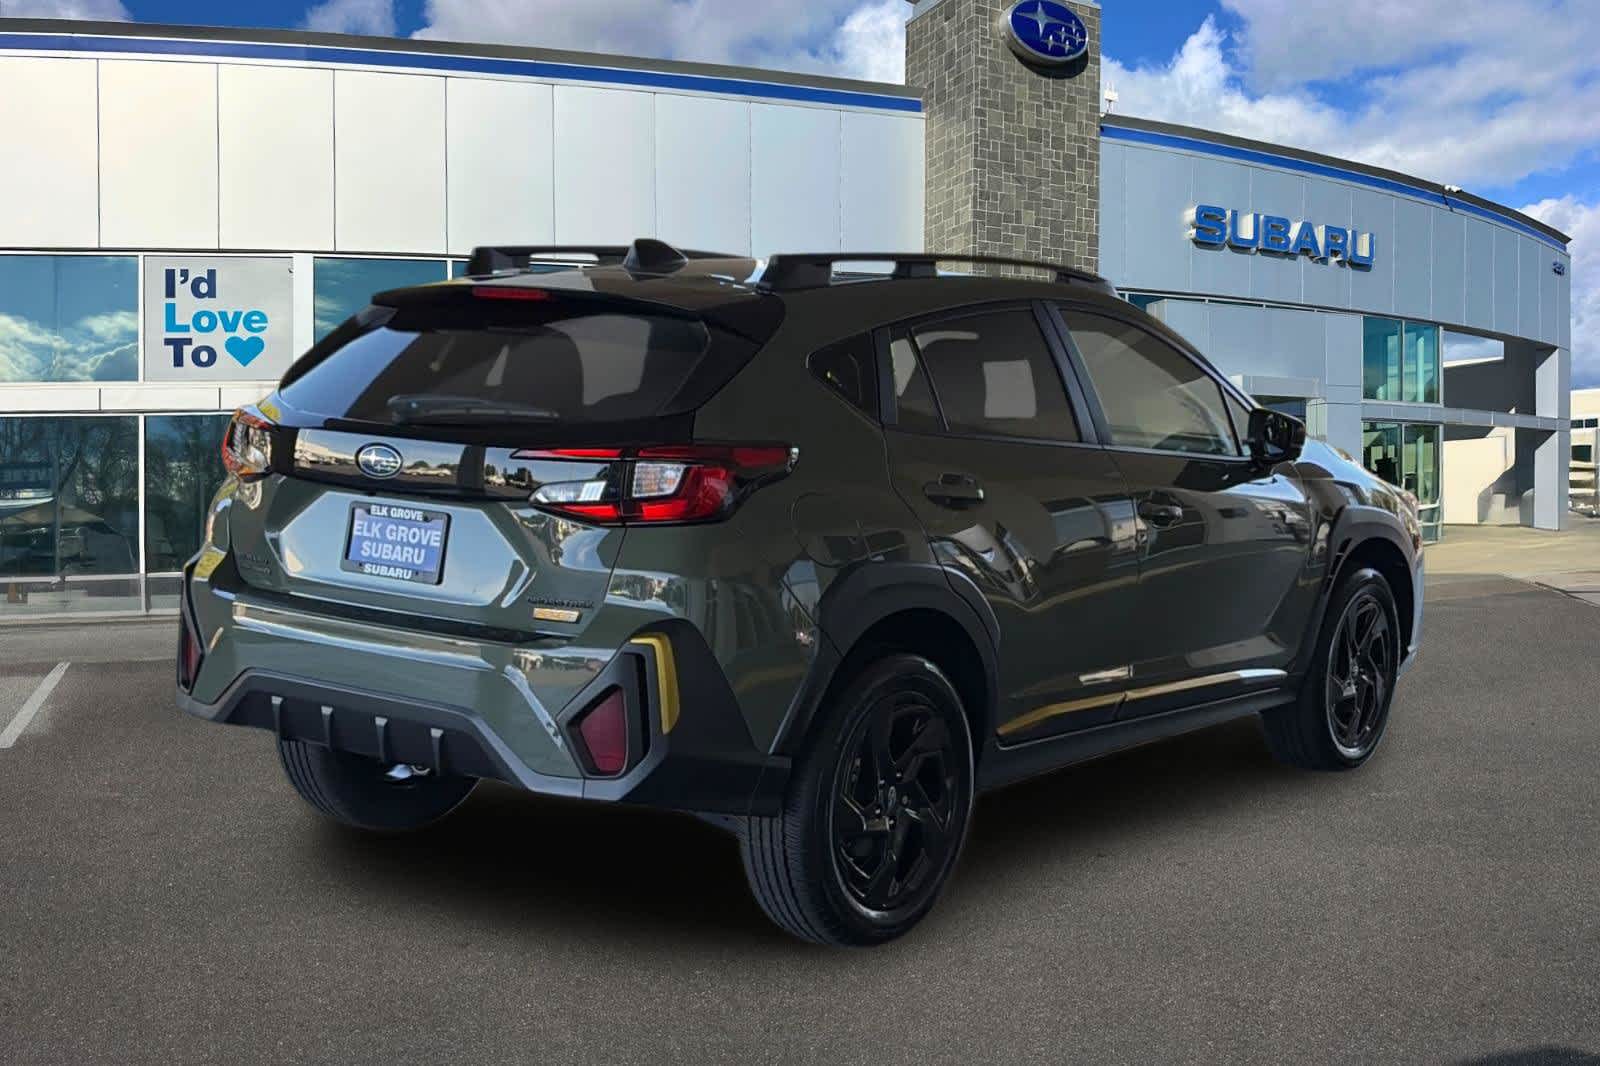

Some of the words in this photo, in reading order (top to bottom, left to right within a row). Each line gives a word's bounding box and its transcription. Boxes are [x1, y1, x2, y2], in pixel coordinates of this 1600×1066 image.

[1191, 204, 1376, 268] SUBARU
[165, 302, 269, 333] Love
[163, 337, 218, 368] To
[370, 504, 388, 517] ELK
[390, 507, 424, 521] GROVE
[353, 520, 382, 538] ELK
[385, 523, 442, 547] GROVE
[360, 540, 426, 565] SUBARU
[363, 563, 413, 580] SUBARU
